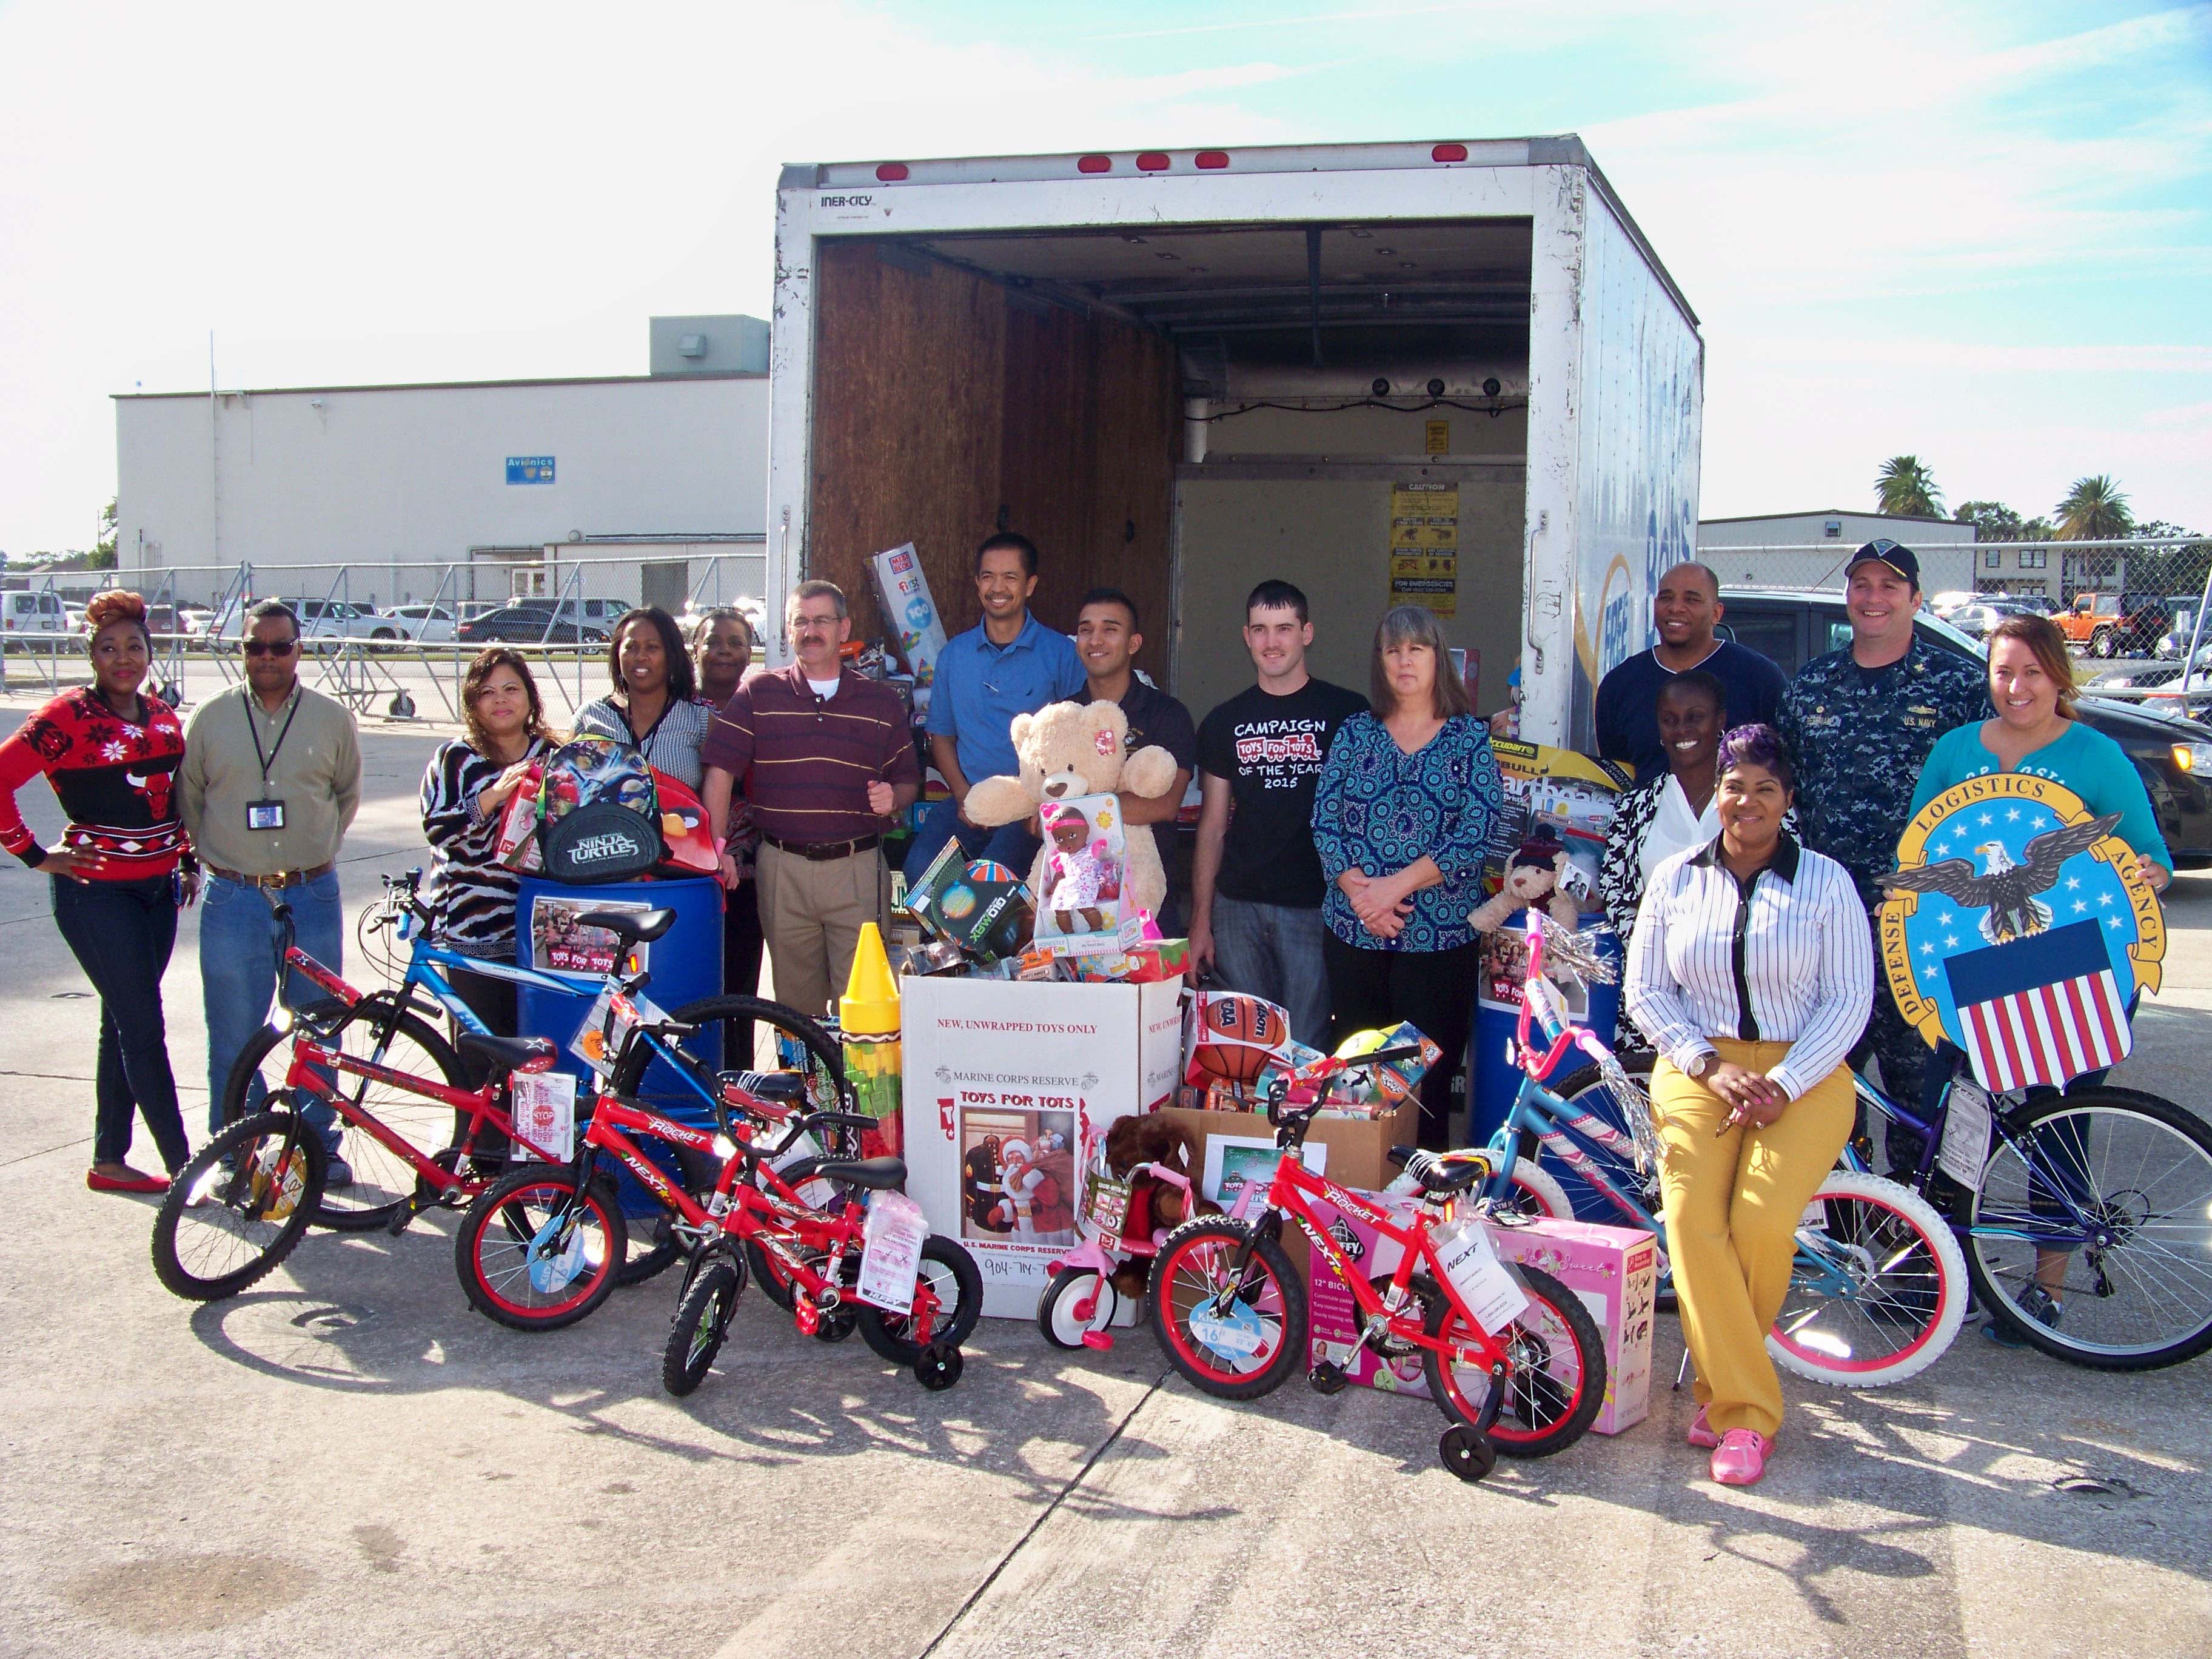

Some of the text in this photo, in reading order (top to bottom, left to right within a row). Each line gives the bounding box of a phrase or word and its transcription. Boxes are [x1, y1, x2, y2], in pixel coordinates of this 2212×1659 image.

[821, 195, 872, 207] INER-CITY
[1234, 719, 1326, 737] CAMPAIGN
[1919, 717, 1937, 727] NAVY
[1239, 742, 1312, 754] TOYS FOR TOTS
[1238, 763, 1323, 776] OF THE YEAR
[1264, 777, 1299, 789] 2015
[1915, 777, 2046, 832] LOGISTICS
[578, 835, 628, 850] NINJA
[566, 839, 640, 864] TURTLES
[2110, 850, 2157, 949] AGENCY
[970, 896, 1007, 942] GLOMAX
[552, 952, 614, 968] TOYS FOR TOTS
[1887, 911, 1920, 1017] DEFENSE
[1495, 983, 1524, 999] TOYS FOR
[937, 1019, 1098, 1034] NEW, UNWRAPPED TOYS ONLY
[954, 1071, 1079, 1086] MARINE CORPS RESERVE
[960, 1091, 1074, 1108] TOYS FOR TOTS
[534, 1110, 554, 1120] STOP
[648, 1121, 707, 1144] ROCKET
[625, 1157, 669, 1191] NEXT
[1250, 1194, 1267, 1202] RIV
[1324, 1190, 1382, 1224] ROCKET
[1300, 1223, 1342, 1269] NEXT
[1338, 1242, 1359, 1254] FFY
[1447, 1242, 1478, 1272] NEXT
[1523, 1246, 1606, 1273] So Sweet
[984, 1258, 1046, 1276] 904-714-7
[1314, 1278, 1350, 1292] 12" BICY
[868, 1291, 902, 1306] HUFFY
